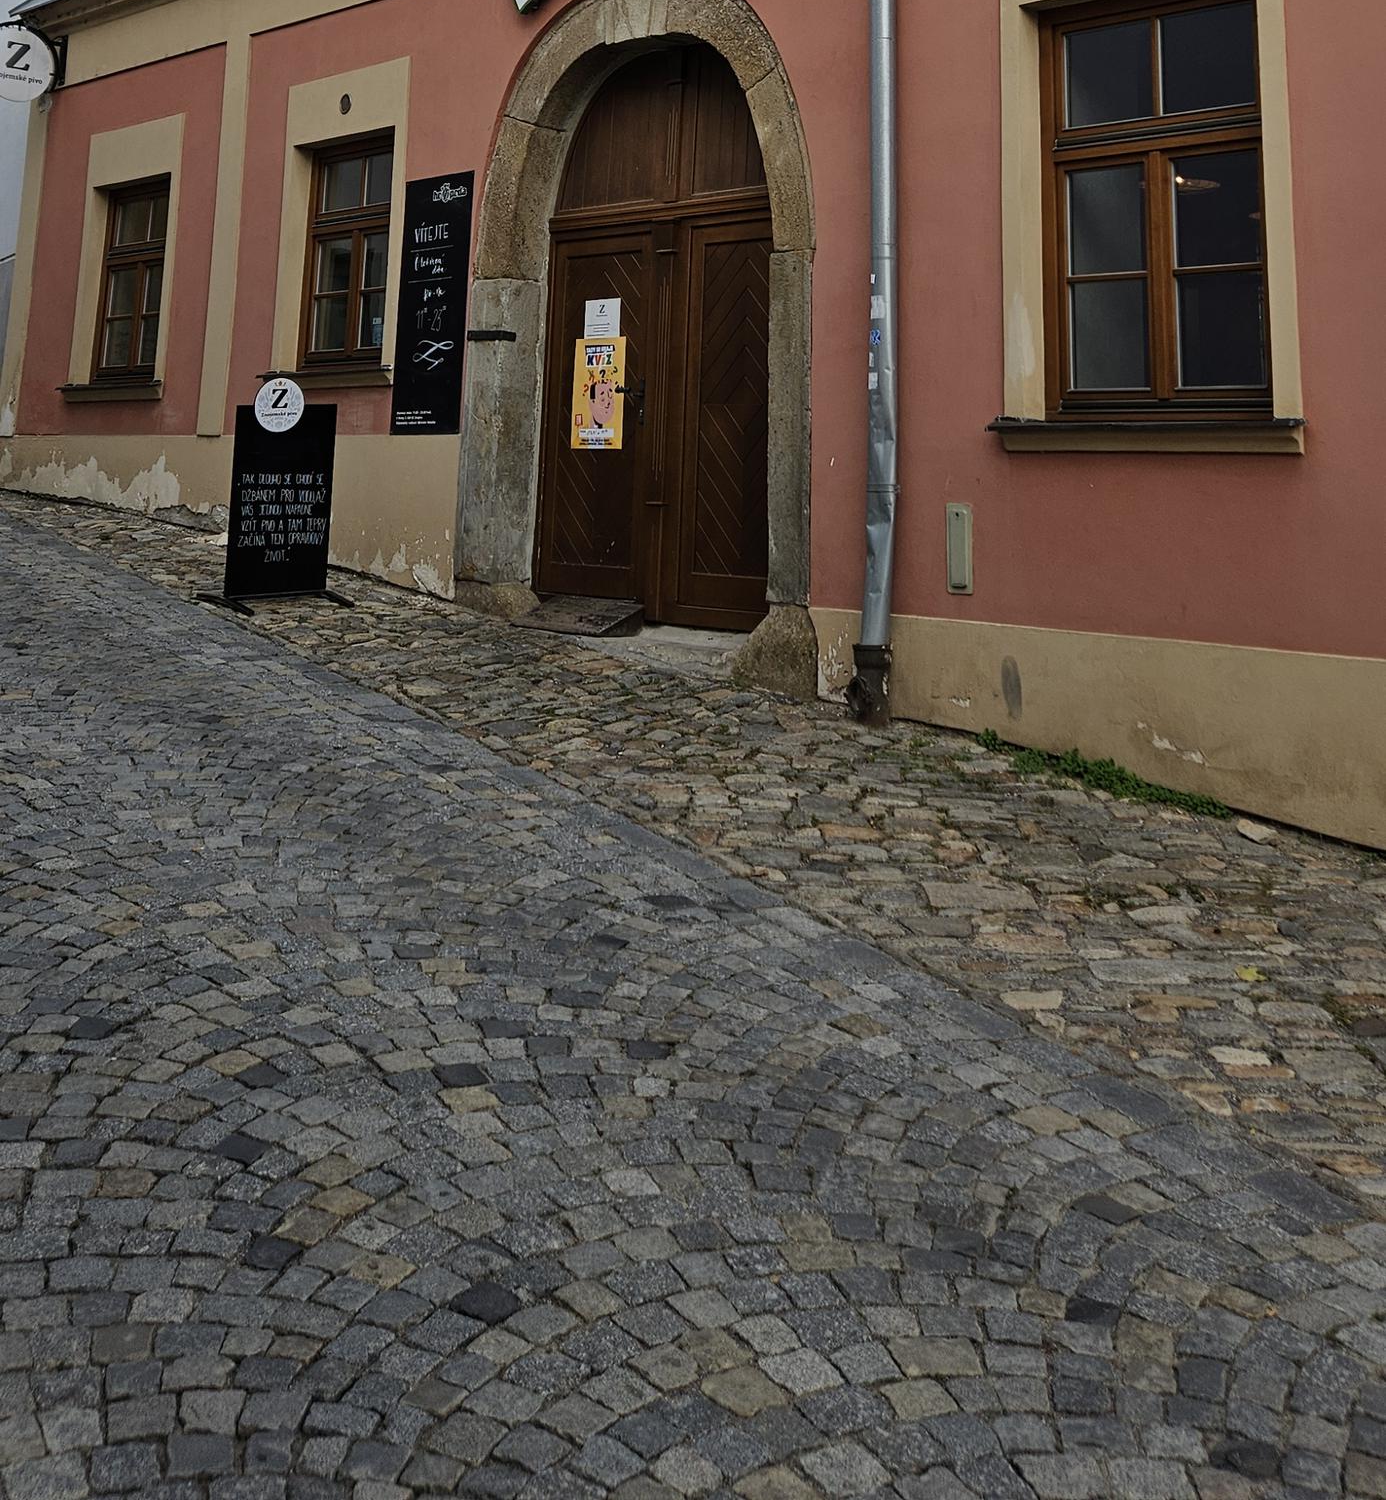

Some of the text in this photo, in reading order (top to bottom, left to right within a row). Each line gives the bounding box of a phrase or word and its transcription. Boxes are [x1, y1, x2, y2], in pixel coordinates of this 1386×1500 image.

[5, 41, 31, 71] Z
[28, 77, 43, 85] pivo
[414, 222, 449, 244] VÍTEJTE
[271, 388, 288, 409] Z
[283, 473, 292, 485] SE
[316, 473, 325, 485] SE
[280, 488, 295, 503] PRO
[241, 516, 257, 532] VZÍT
[278, 519, 284, 532] A
[287, 518, 303, 532] TAM
[237, 531, 266, 547] ZAČÍNÁ
[271, 532, 285, 545] TEN
